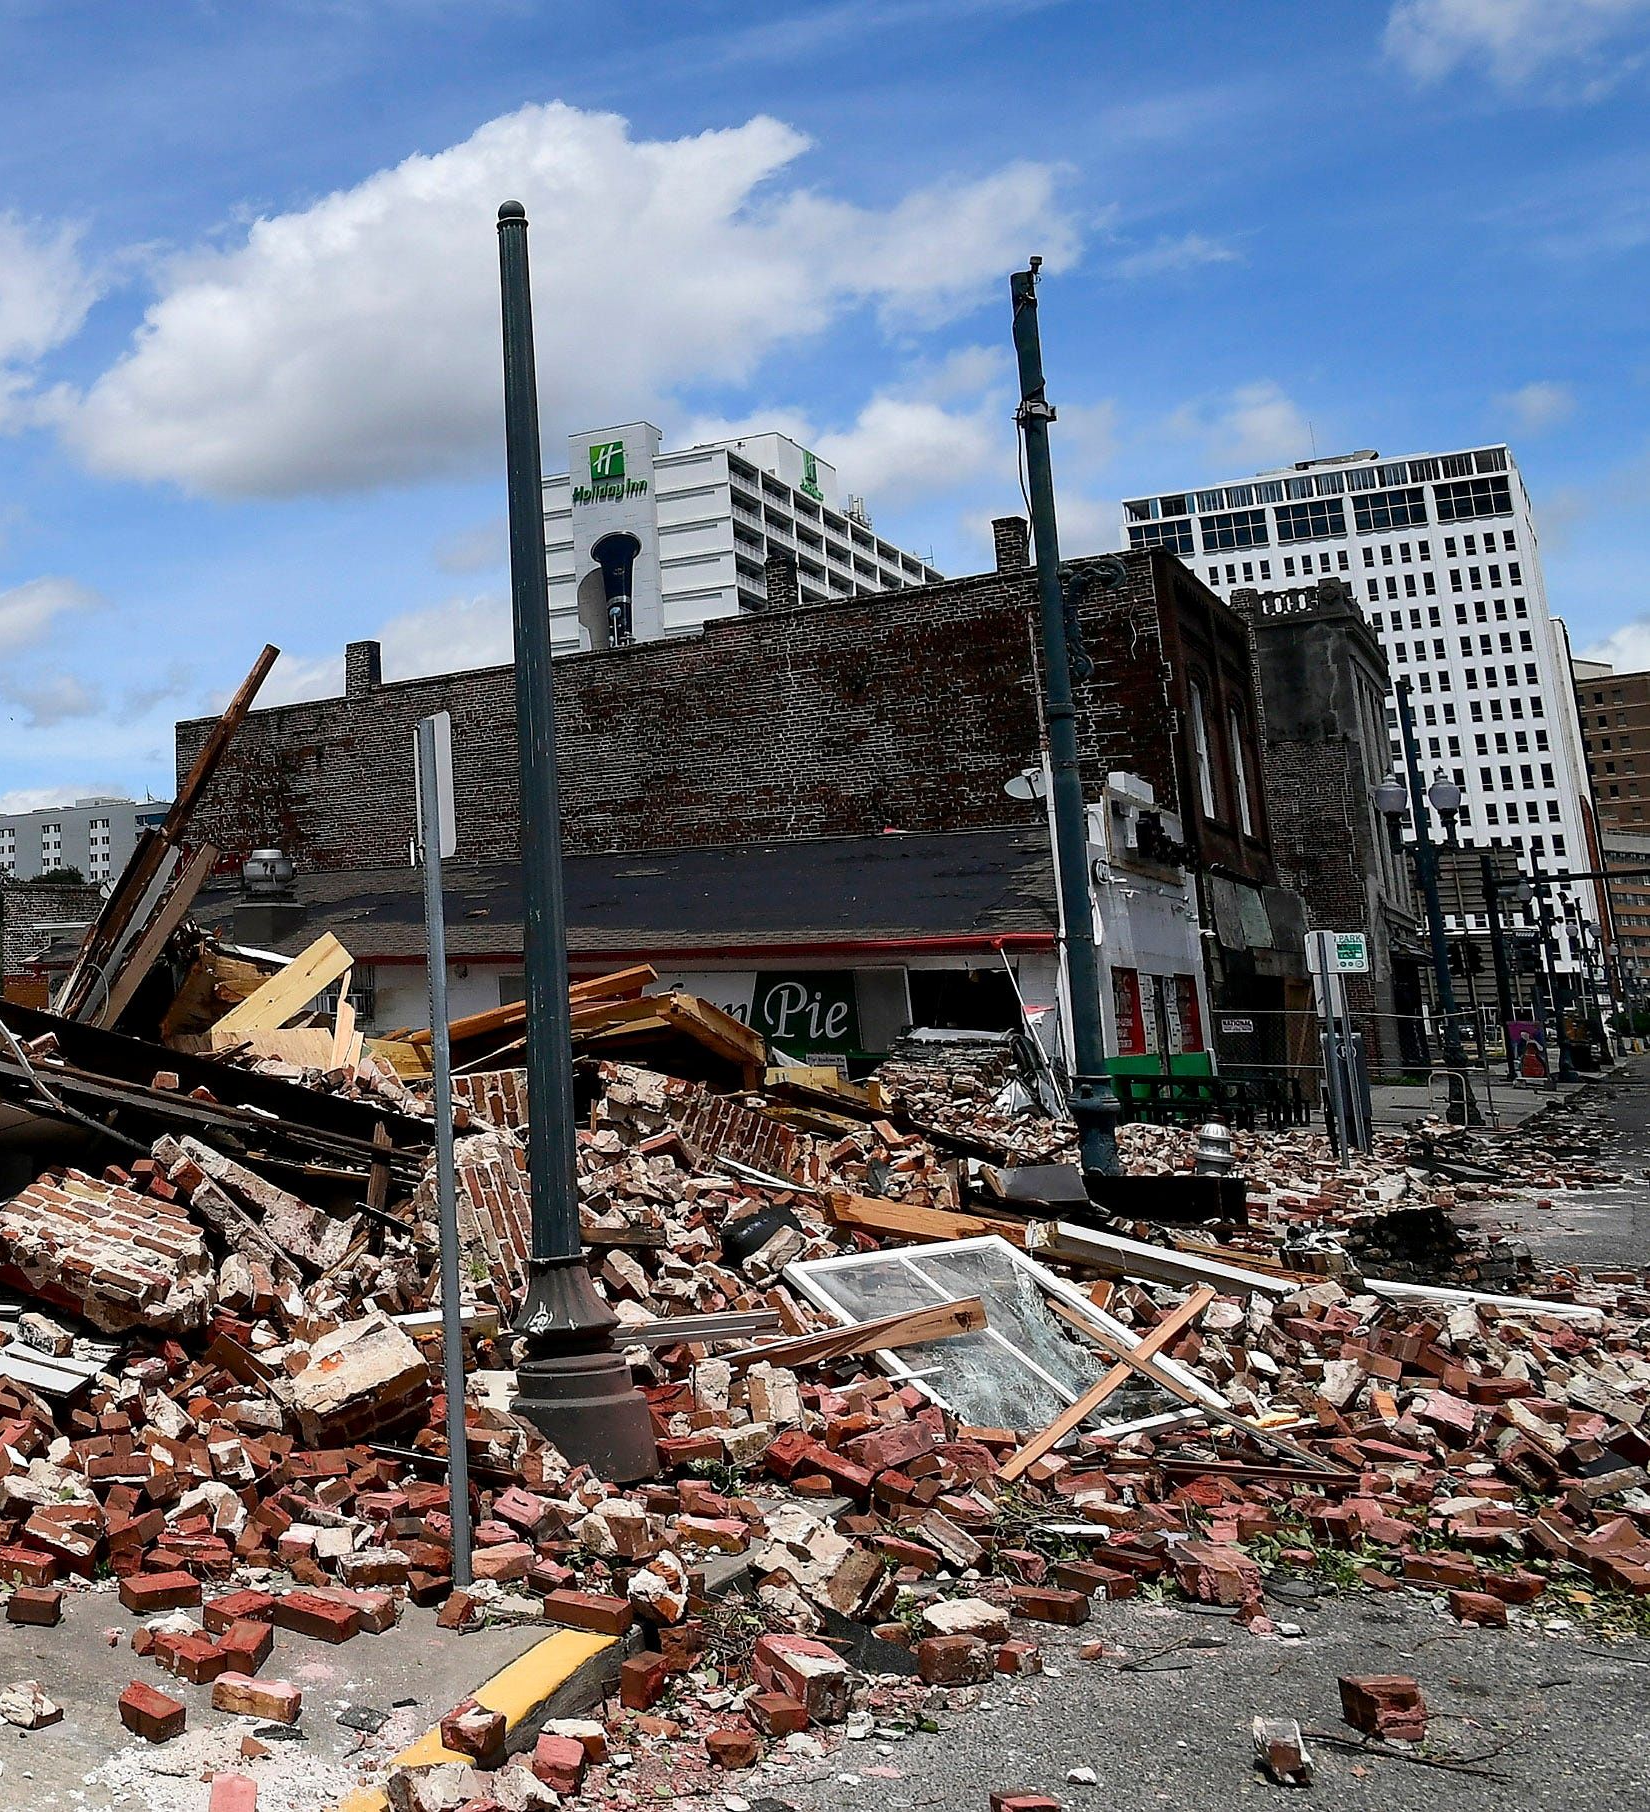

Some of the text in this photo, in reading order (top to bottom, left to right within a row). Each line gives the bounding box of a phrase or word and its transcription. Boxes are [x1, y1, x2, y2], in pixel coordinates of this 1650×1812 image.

[572, 478, 648, 505] Holiday Inn
[1339, 935, 1361, 943] PARK
[764, 981, 848, 1038] Pie
